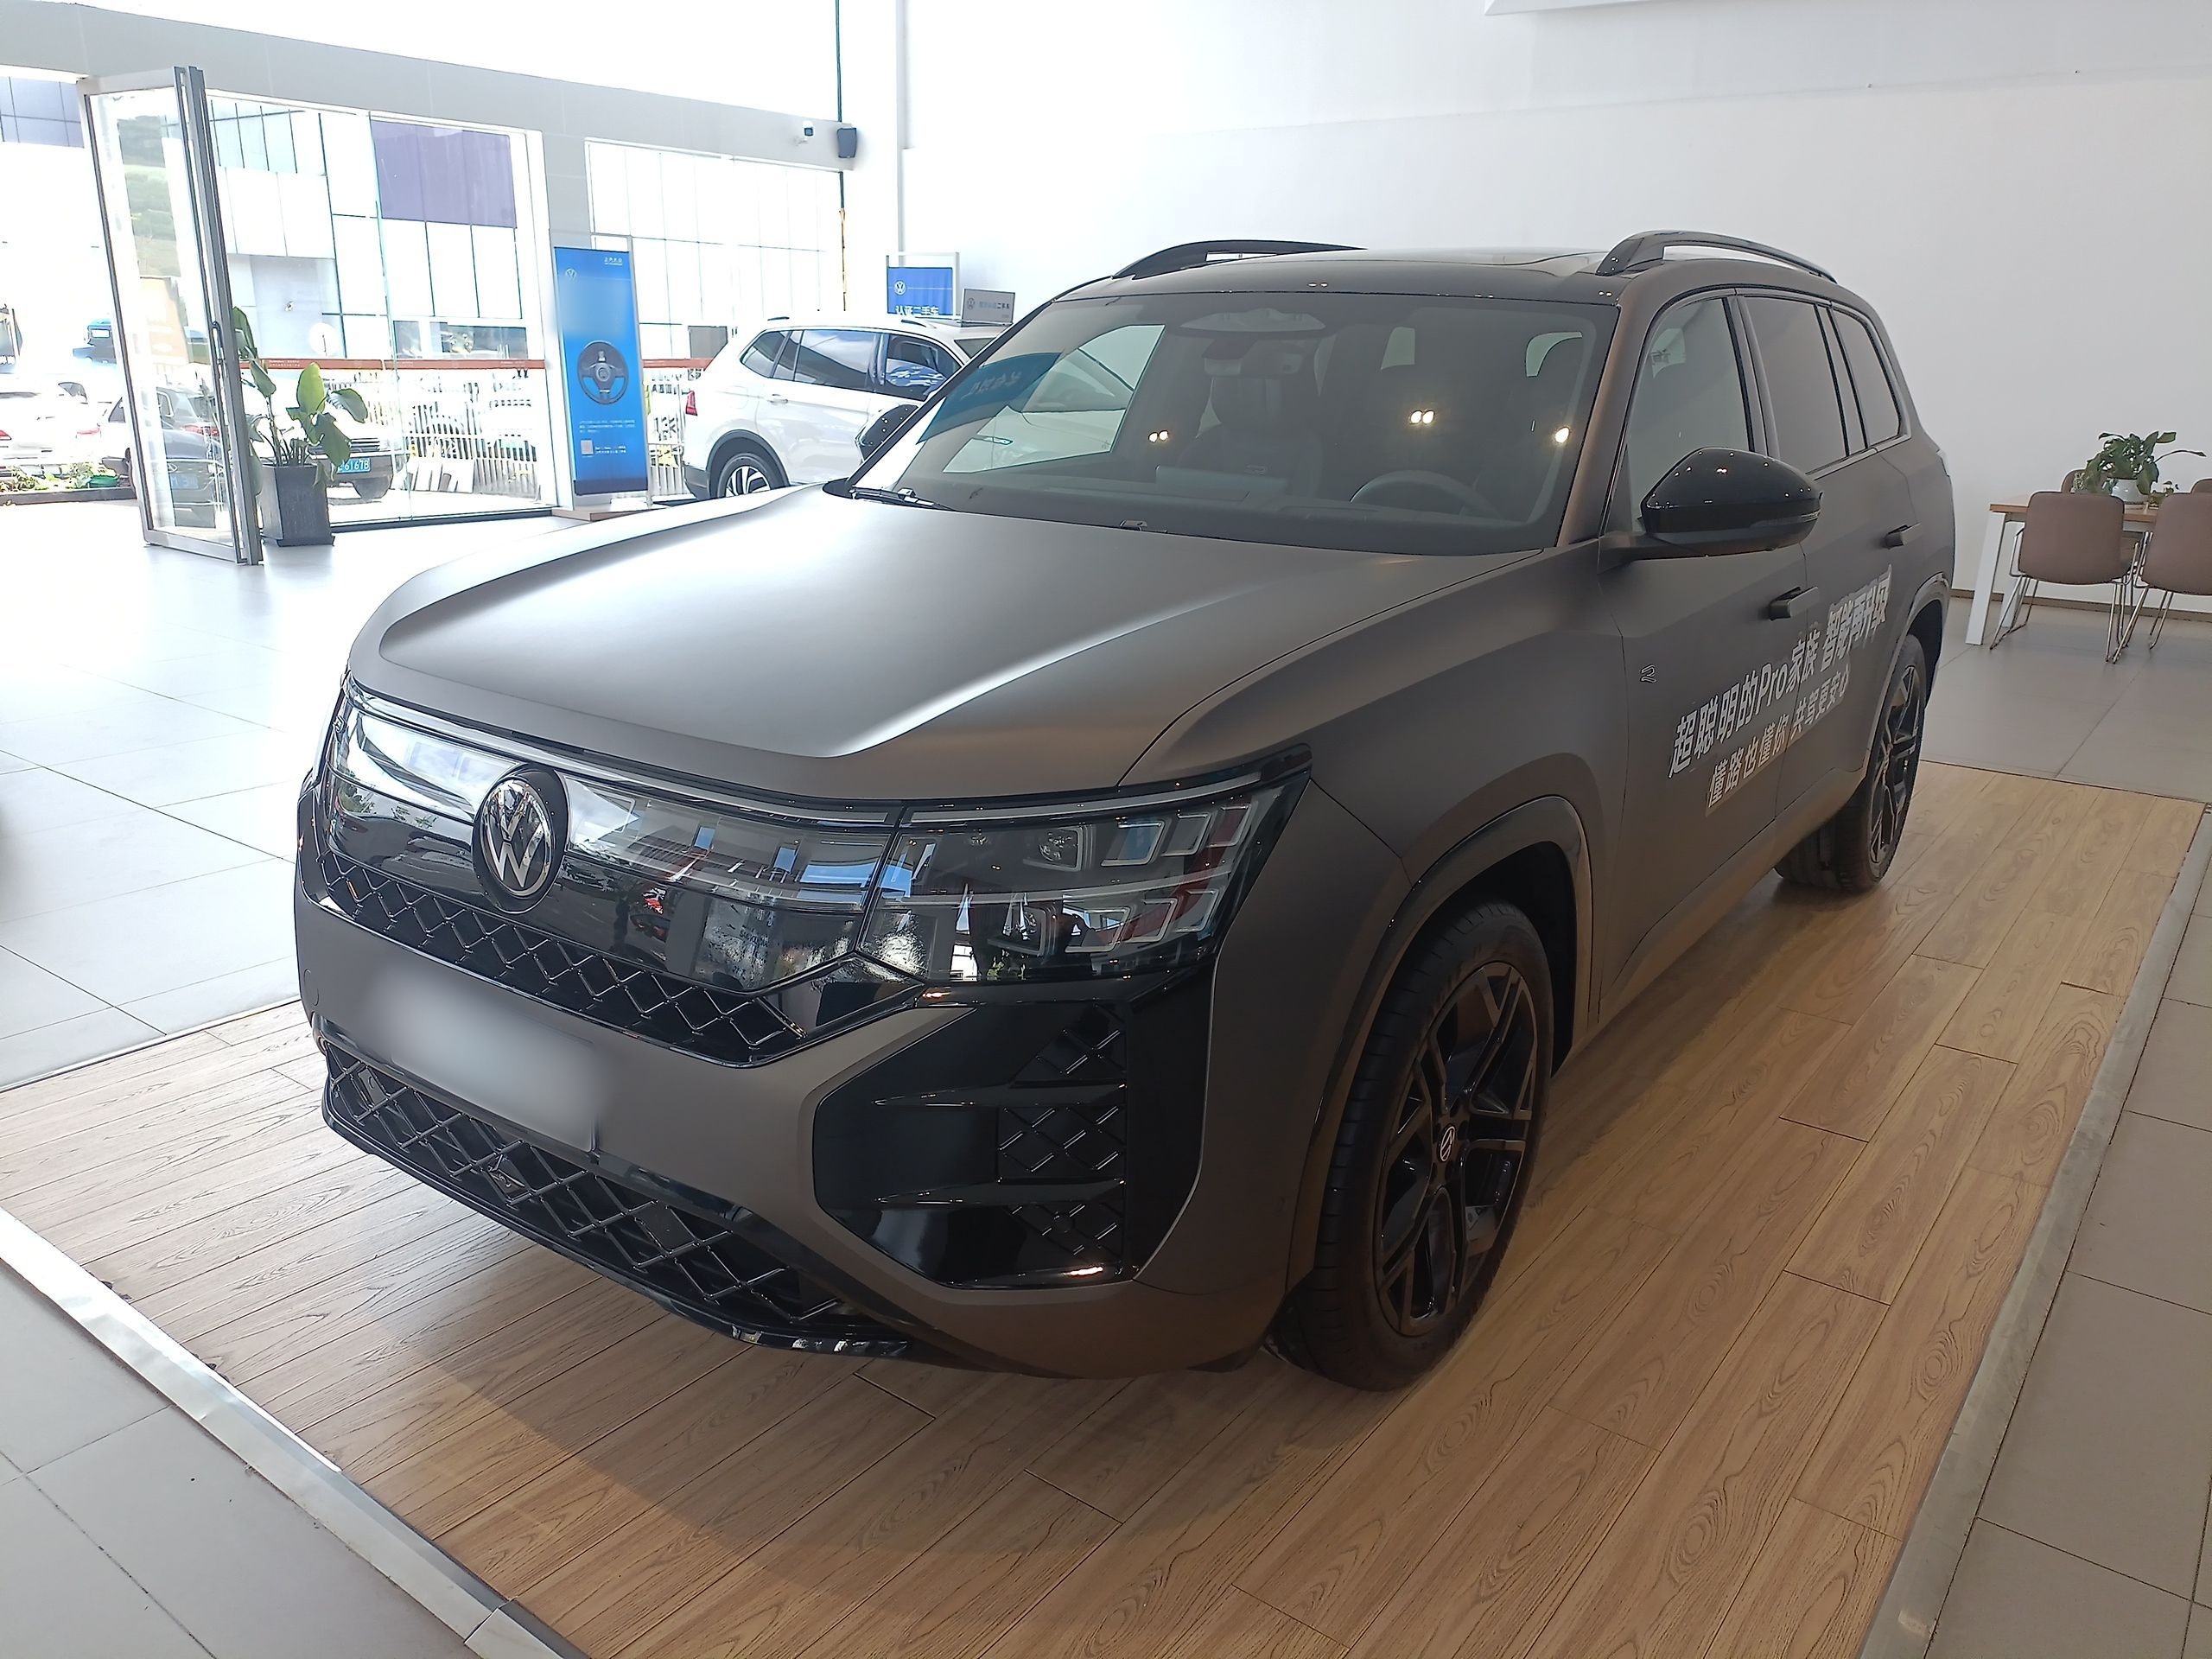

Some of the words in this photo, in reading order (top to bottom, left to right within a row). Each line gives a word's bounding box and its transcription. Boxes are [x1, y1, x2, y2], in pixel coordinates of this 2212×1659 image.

[338, 458, 371, 472] 6167B
[1669, 629, 1821, 778] 超聪明的Pro家族
[1708, 713, 1789, 808] 懂路也懂你
